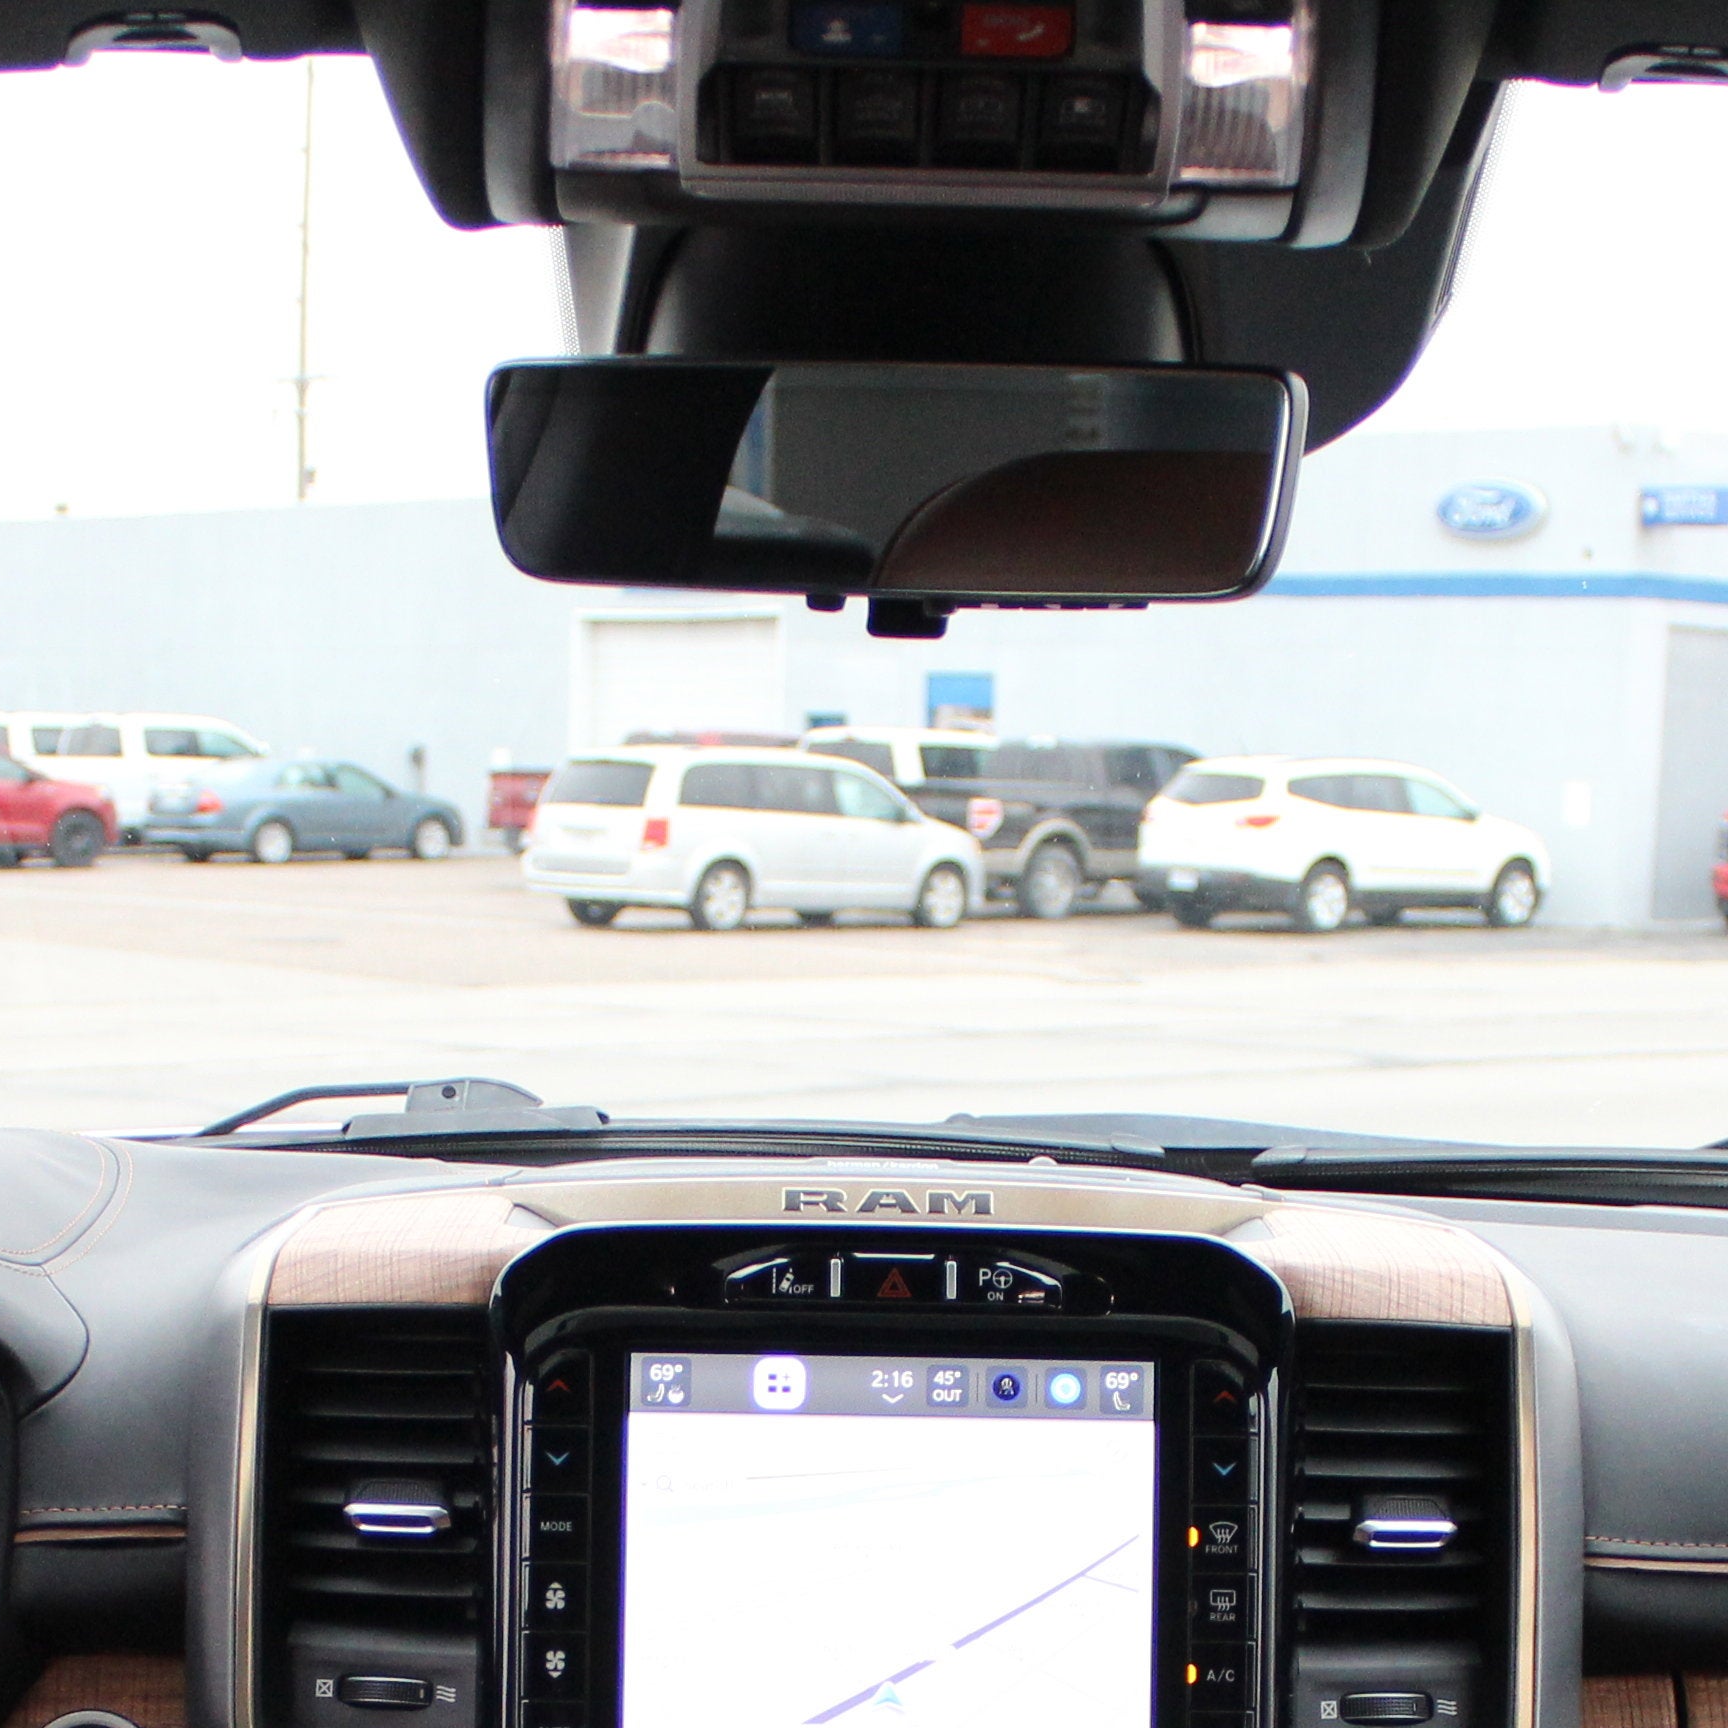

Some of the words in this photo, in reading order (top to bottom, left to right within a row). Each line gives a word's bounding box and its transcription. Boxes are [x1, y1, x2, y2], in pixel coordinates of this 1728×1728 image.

[782, 1187, 995, 1216] RAM
[792, 1284, 815, 1295] OFF
[987, 1291, 1004, 1302] ON
[649, 1363, 683, 1382] 69°
[871, 1370, 914, 1388] 2:16
[933, 1370, 962, 1386] 45°
[1105, 1371, 1139, 1390] 69°
[932, 1389, 962, 1403] OUT
[540, 1521, 573, 1532] MODE
[1205, 1544, 1239, 1554] FRONT
[1209, 1612, 1236, 1622] REAR
[1206, 1669, 1236, 1682] A/C
